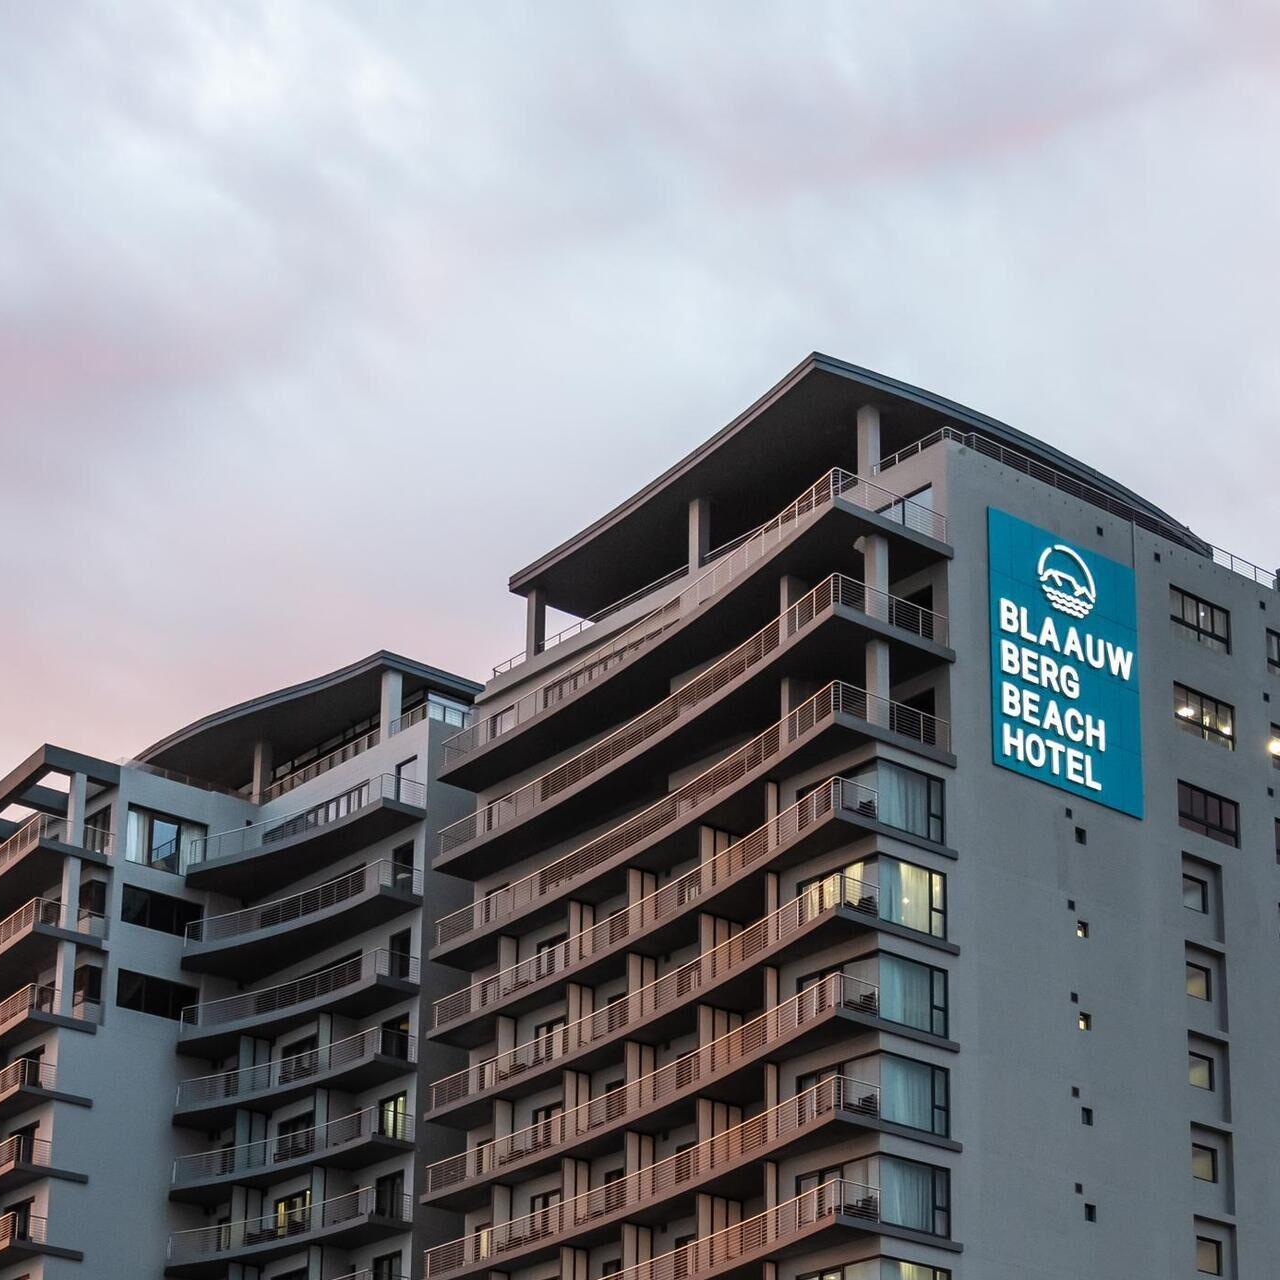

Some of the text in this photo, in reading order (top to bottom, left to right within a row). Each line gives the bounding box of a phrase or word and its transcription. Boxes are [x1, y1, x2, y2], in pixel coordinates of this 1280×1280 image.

[999, 597, 1133, 681] BLAAUW
[1000, 640, 1080, 699] BERG
[1001, 681, 1106, 752] BEACH
[1002, 723, 1102, 791] HOTEL
